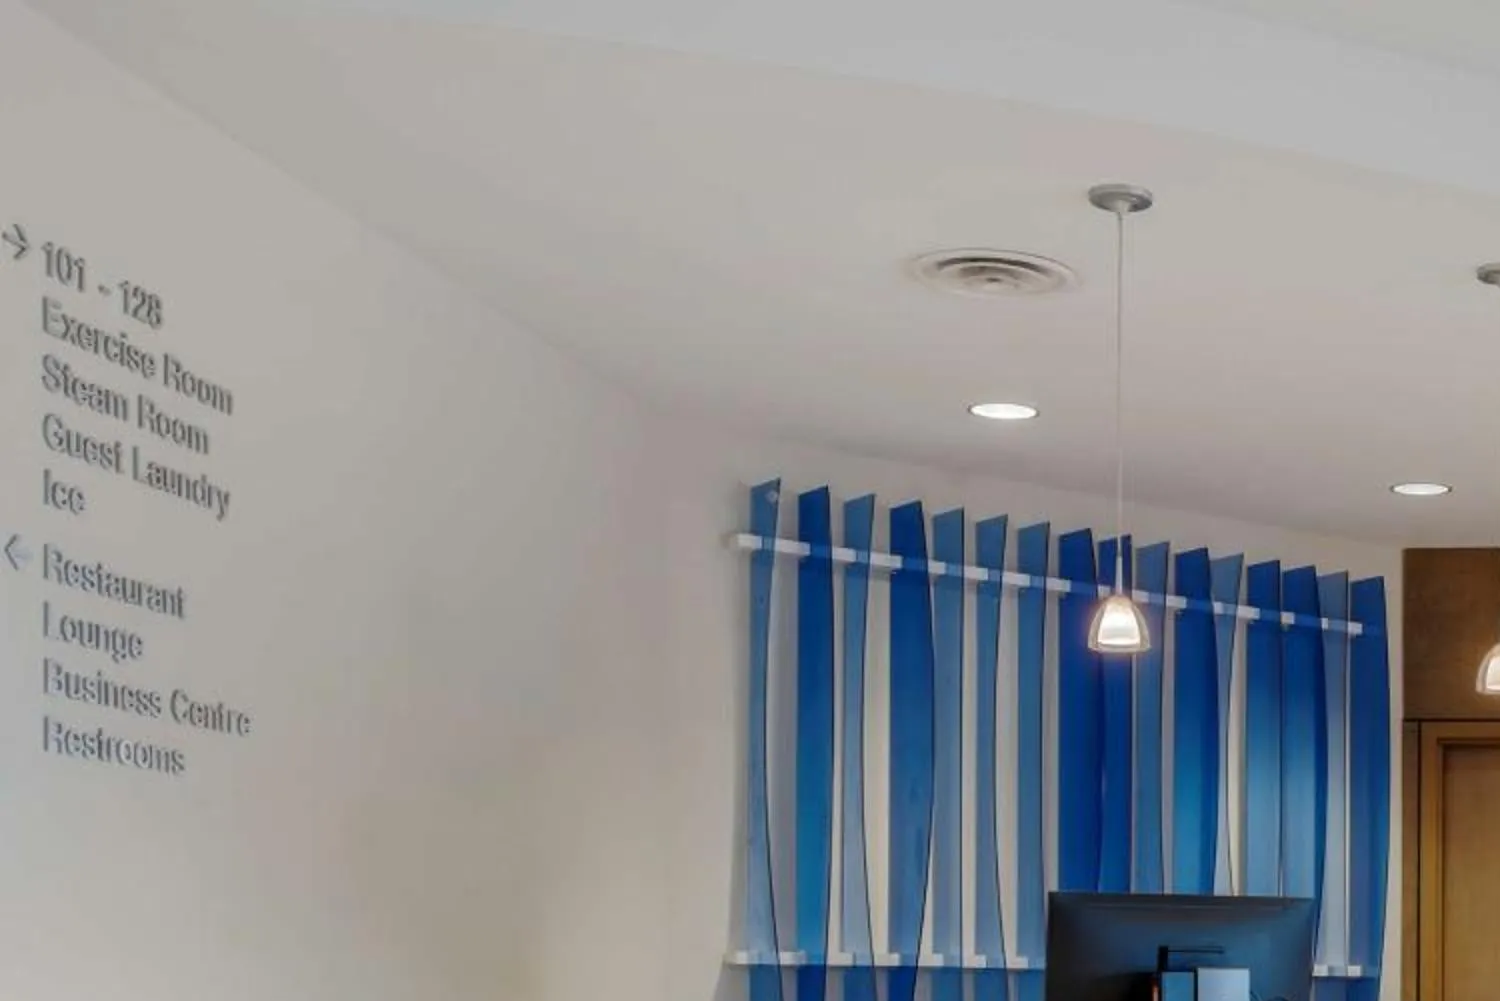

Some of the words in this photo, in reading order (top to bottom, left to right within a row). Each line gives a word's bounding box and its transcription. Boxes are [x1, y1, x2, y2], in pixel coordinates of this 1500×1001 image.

[41, 241, 86, 293] 101
[42, 295, 156, 379] Exercise
[163, 352, 233, 416] Room
[41, 353, 129, 421] Steam
[137, 393, 209, 454] Room
[42, 412, 124, 475] Guest
[132, 445, 230, 522] Laundry
[43, 468, 85, 515] Ice
[43, 543, 185, 619] Restaurant
[43, 601, 143, 663] Lounge
[43, 657, 162, 718] Business
[170, 688, 251, 737] Centre
[43, 715, 186, 775] Restrooms
